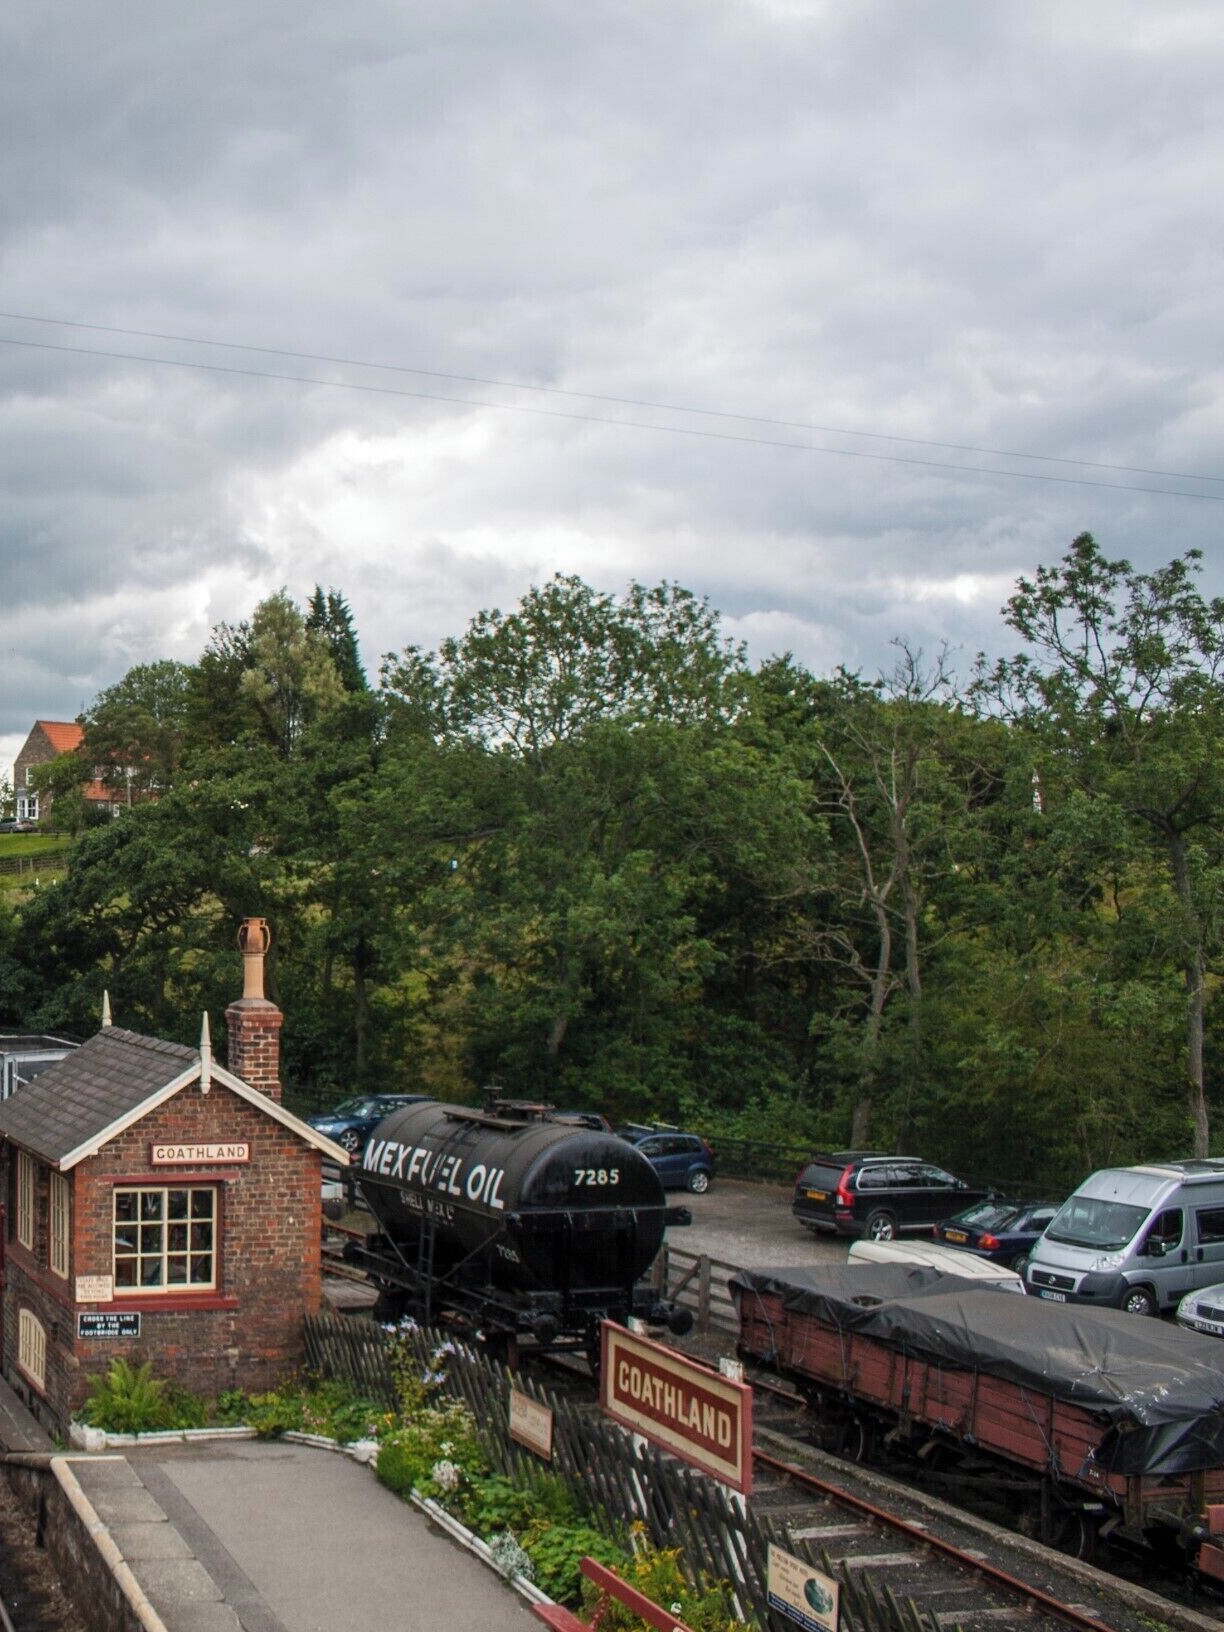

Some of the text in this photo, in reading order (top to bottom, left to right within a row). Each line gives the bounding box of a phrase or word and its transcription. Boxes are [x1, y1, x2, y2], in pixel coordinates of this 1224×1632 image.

[156, 1146, 246, 1159] GOATHLAND
[362, 1138, 505, 1211] MEX FUEL OIL
[574, 1168, 620, 1186] 7285
[618, 1360, 732, 1448] GOATHLAND
